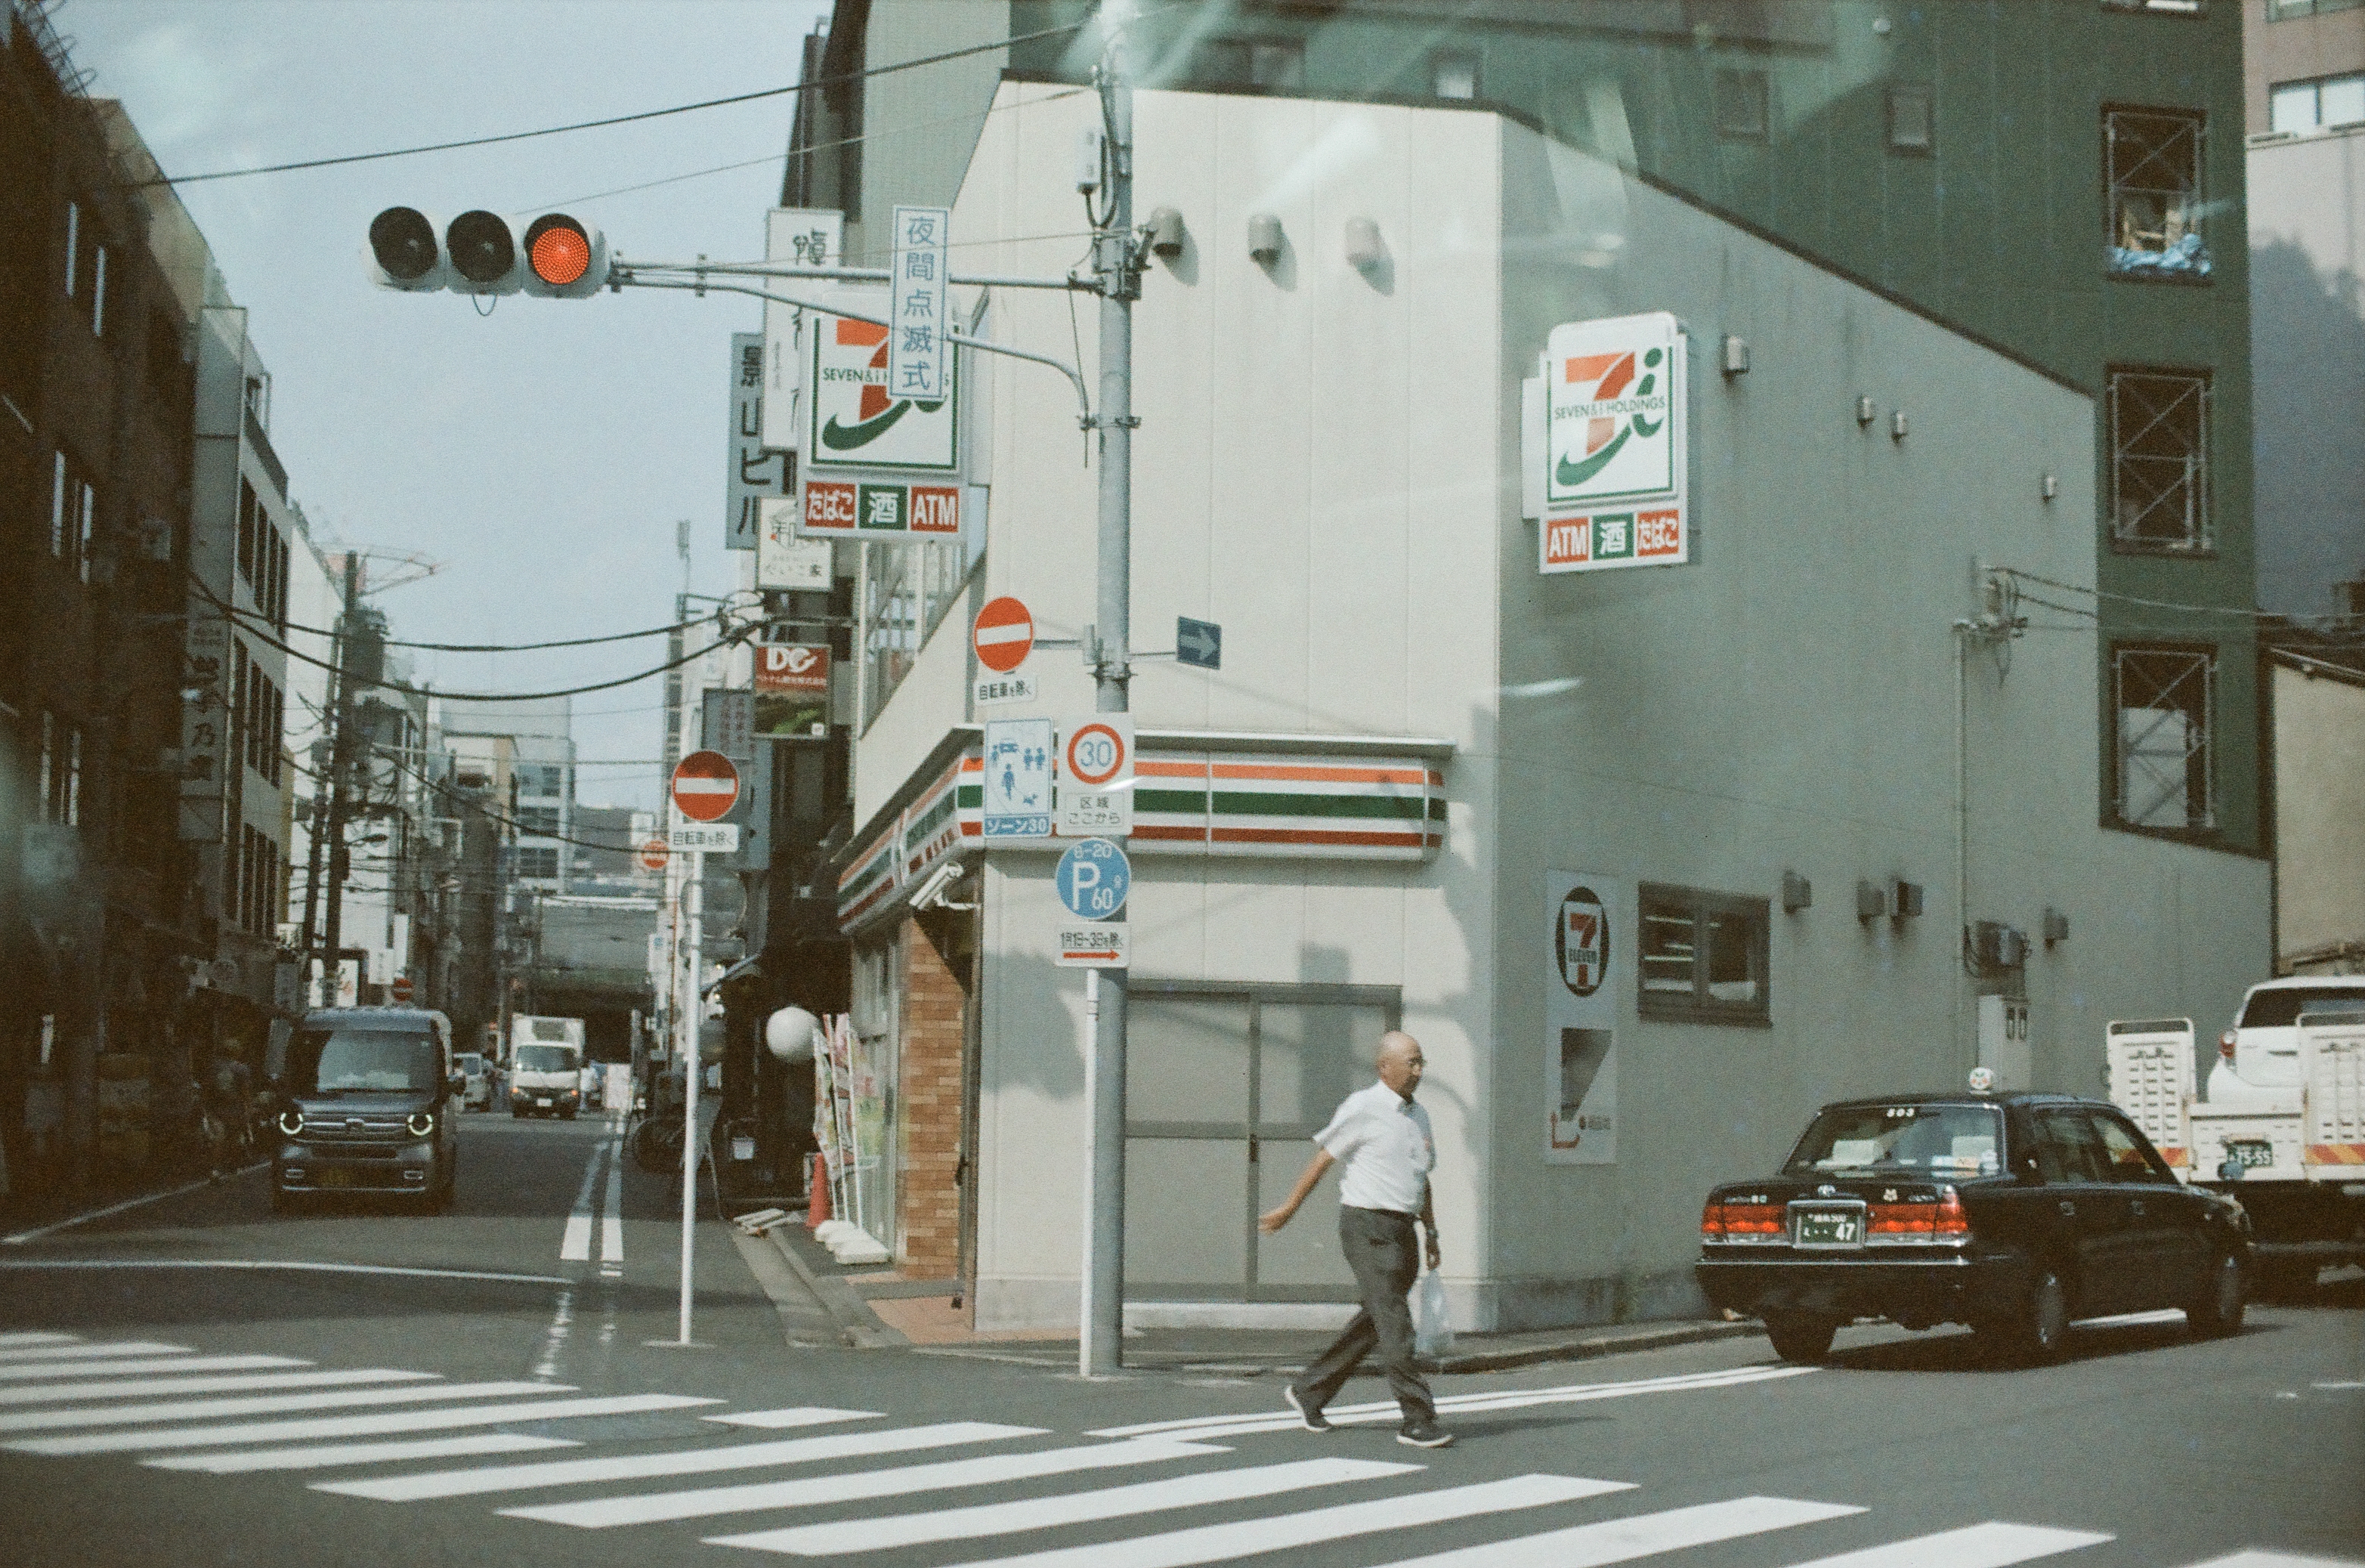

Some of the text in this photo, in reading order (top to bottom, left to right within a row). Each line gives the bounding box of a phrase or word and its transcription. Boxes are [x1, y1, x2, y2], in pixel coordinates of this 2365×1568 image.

[901, 216, 937, 391] 夜間点滅式
[807, 490, 855, 521] たばこ
[869, 490, 897, 522] 酒
[914, 493, 956, 525] ATM
[1549, 525, 1586, 558] ATM
[1600, 521, 1627, 554] 酒
[1638, 517, 1678, 550] たばこ
[979, 680, 1032, 700] 自転車を除く
[1080, 741, 1113, 767] 30
[1068, 812, 1121, 824] ここから
[1080, 796, 1109, 809] 区域
[673, 830, 734, 846] 自転車を除く
[1072, 861, 1101, 911] P
